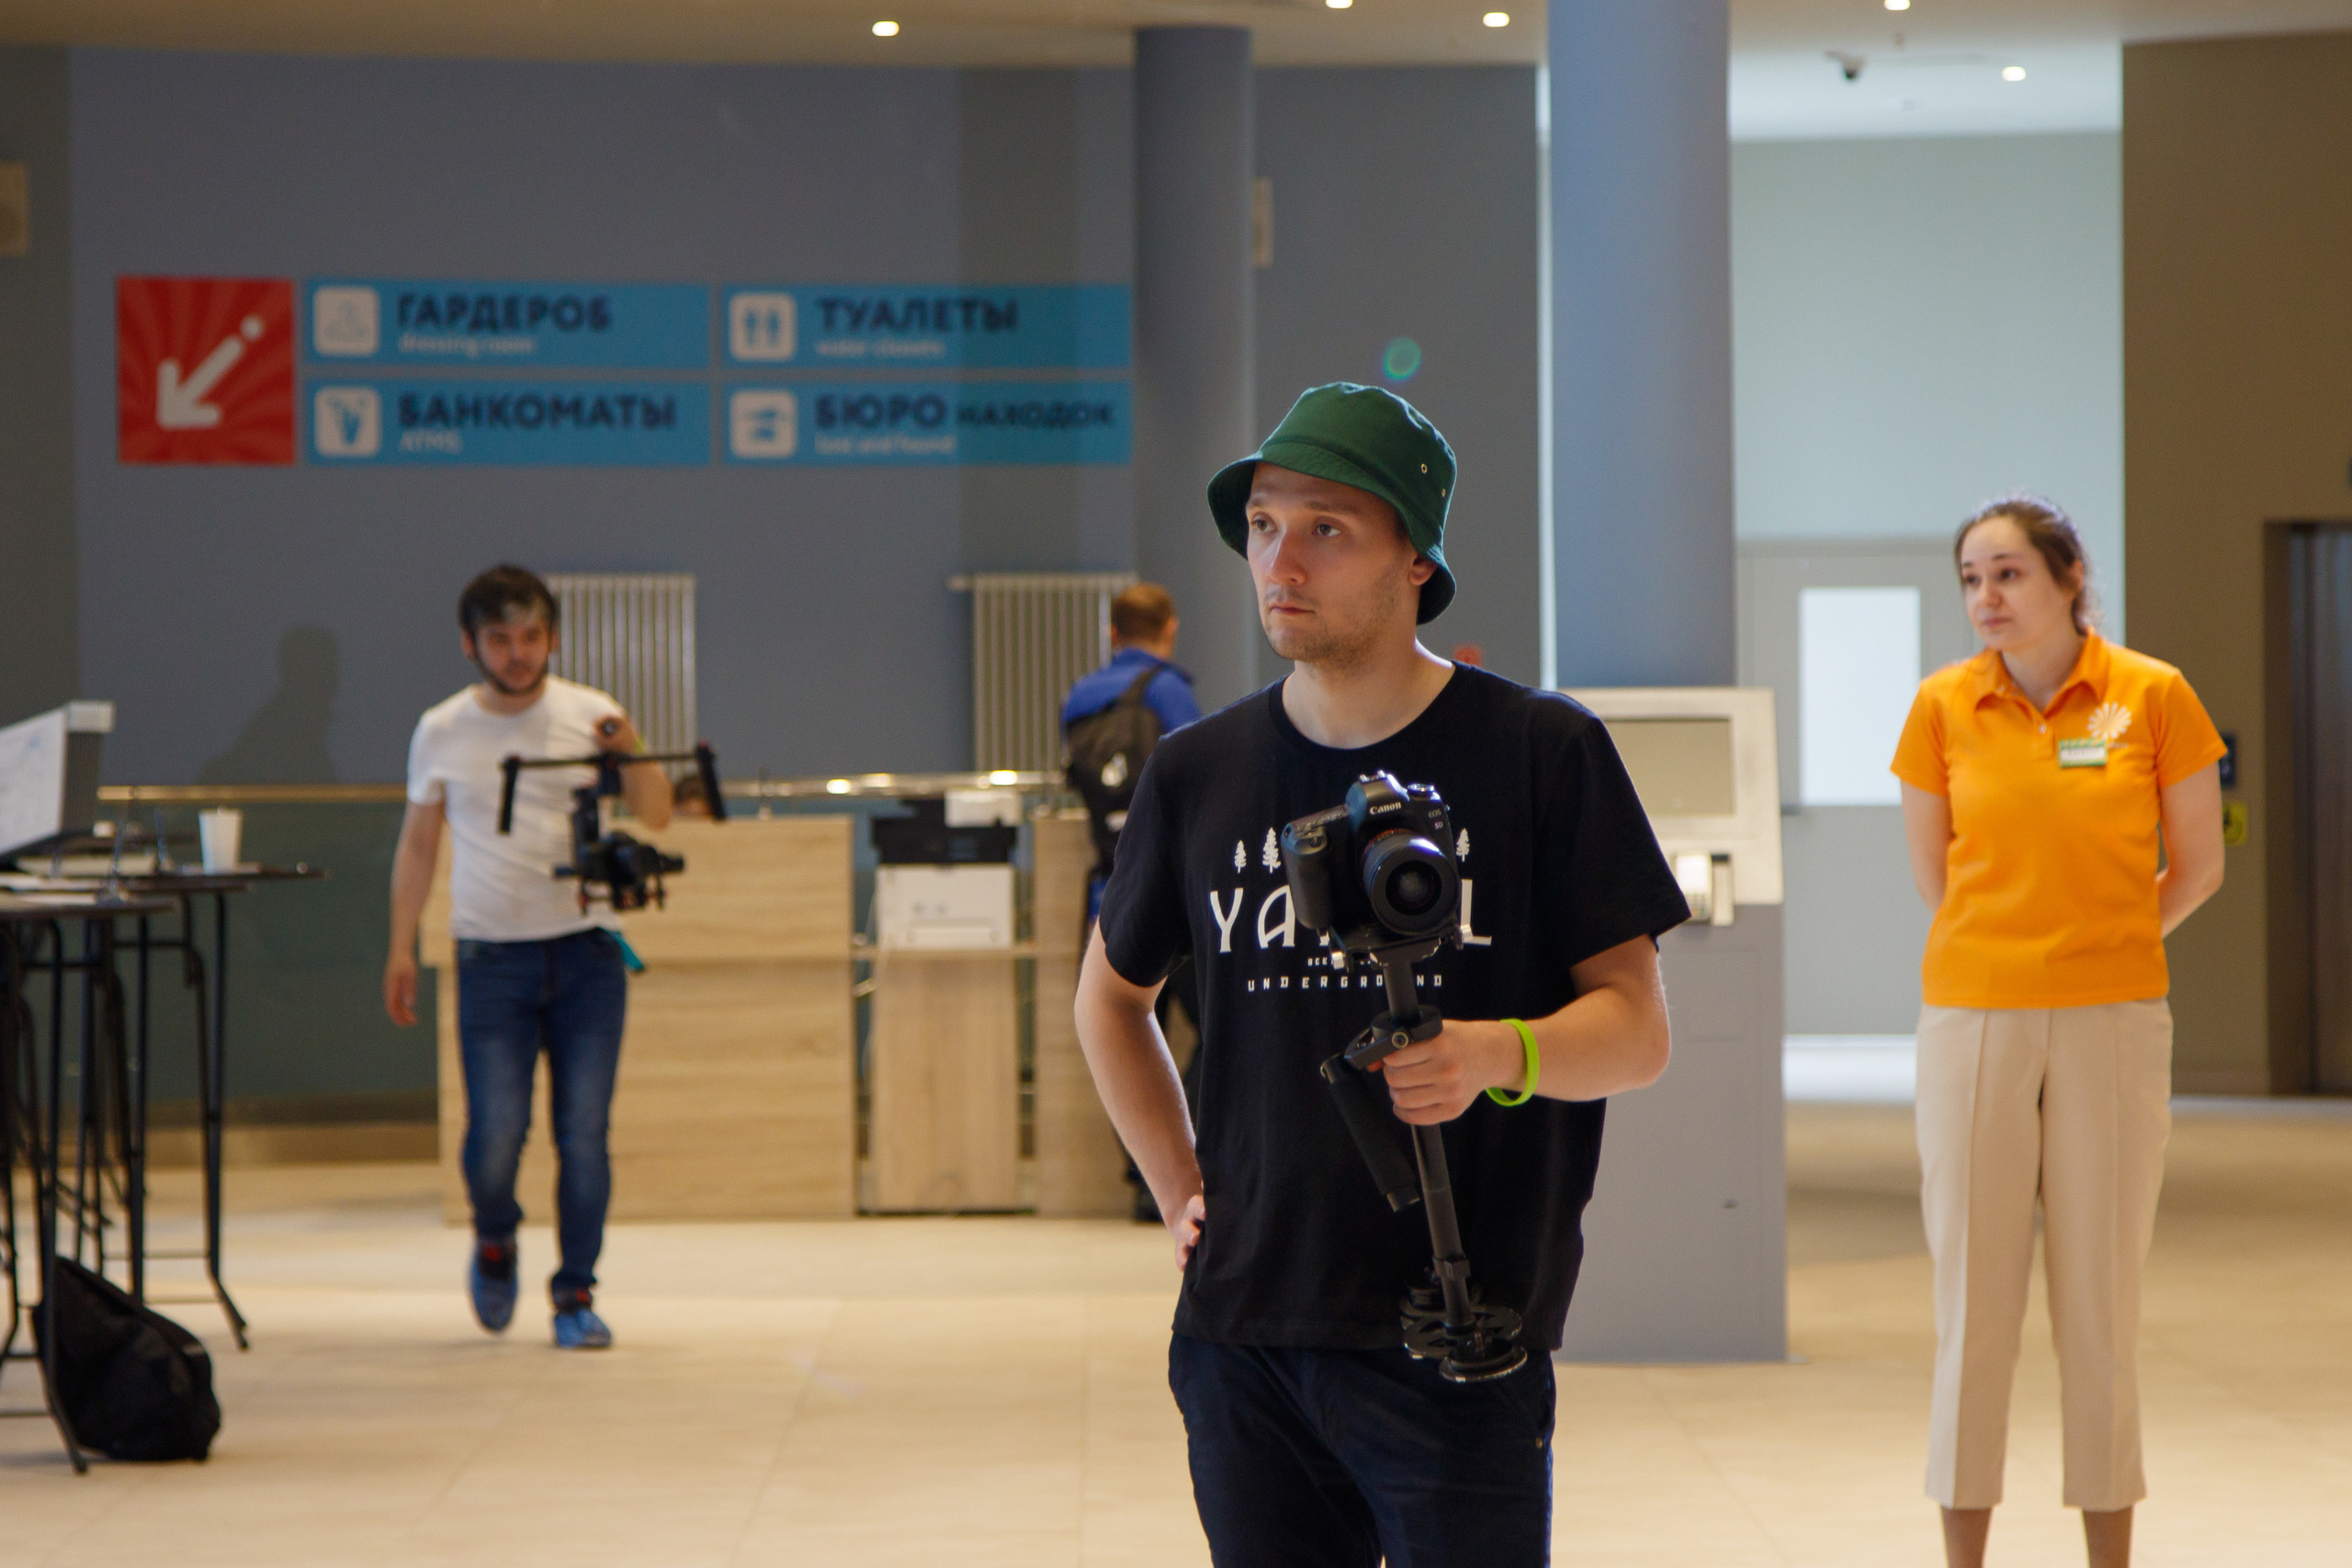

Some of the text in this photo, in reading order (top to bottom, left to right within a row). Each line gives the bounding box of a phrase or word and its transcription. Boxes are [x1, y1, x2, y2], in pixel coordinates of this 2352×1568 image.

[397, 293, 610, 333] ГАРДЕРОБ
[817, 296, 1017, 332] ТУАЛЕТЫ
[398, 393, 676, 429] БАНКОМАТЫ
[815, 393, 945, 429] БЮРО
[1369, 802, 1402, 816] Canon
[1428, 808, 1442, 818] EOS
[1209, 878, 1492, 953] YAL
[1248, 974, 1442, 992] UNDERGROND
